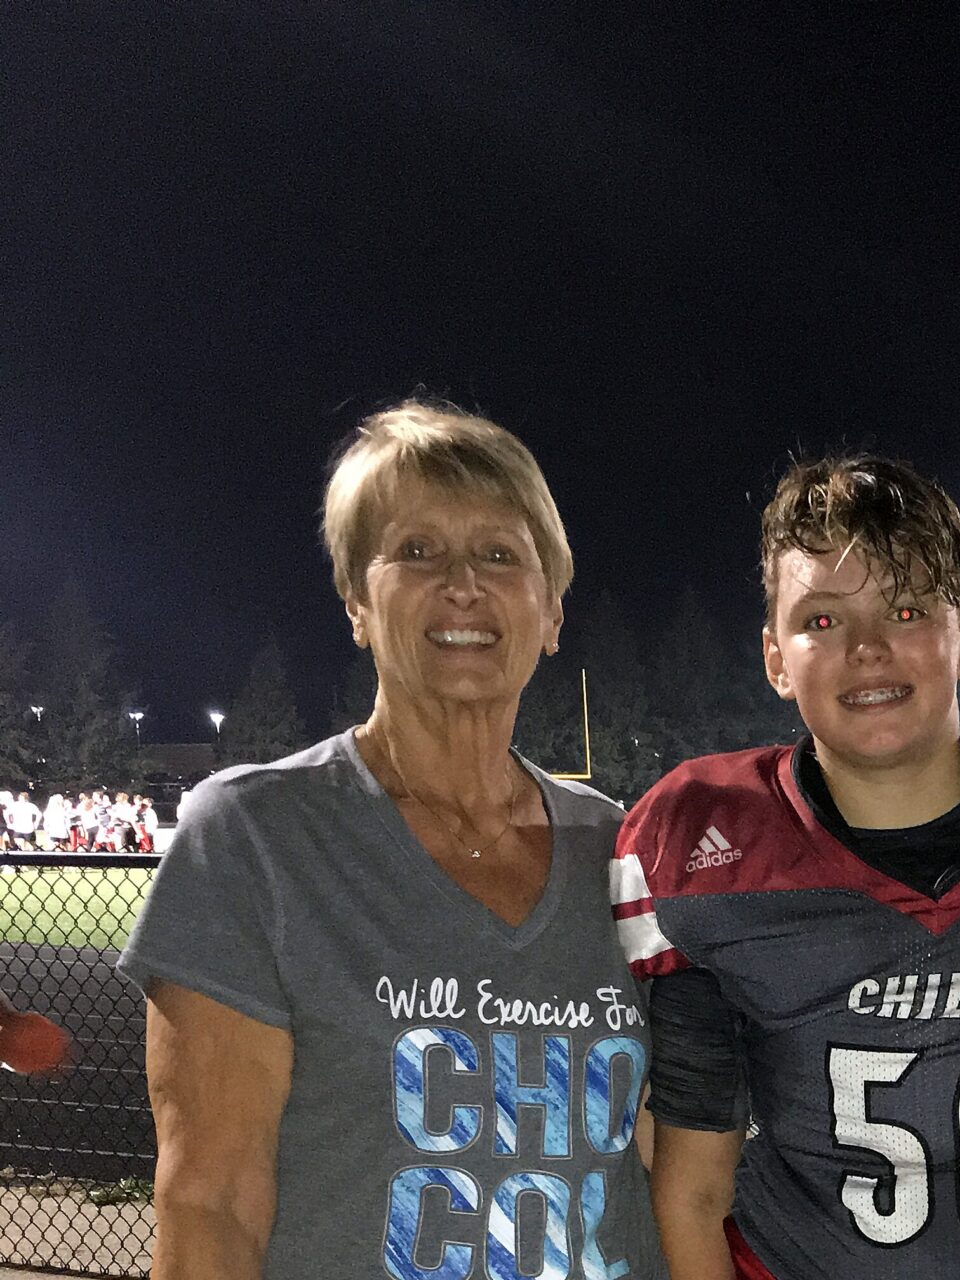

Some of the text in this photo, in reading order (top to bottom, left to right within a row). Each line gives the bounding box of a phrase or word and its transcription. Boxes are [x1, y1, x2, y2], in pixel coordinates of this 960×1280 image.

[686, 849, 743, 873] adidas
[376, 976, 645, 1031] Will Exercise For
[392, 1026, 647, 1159] CHO
